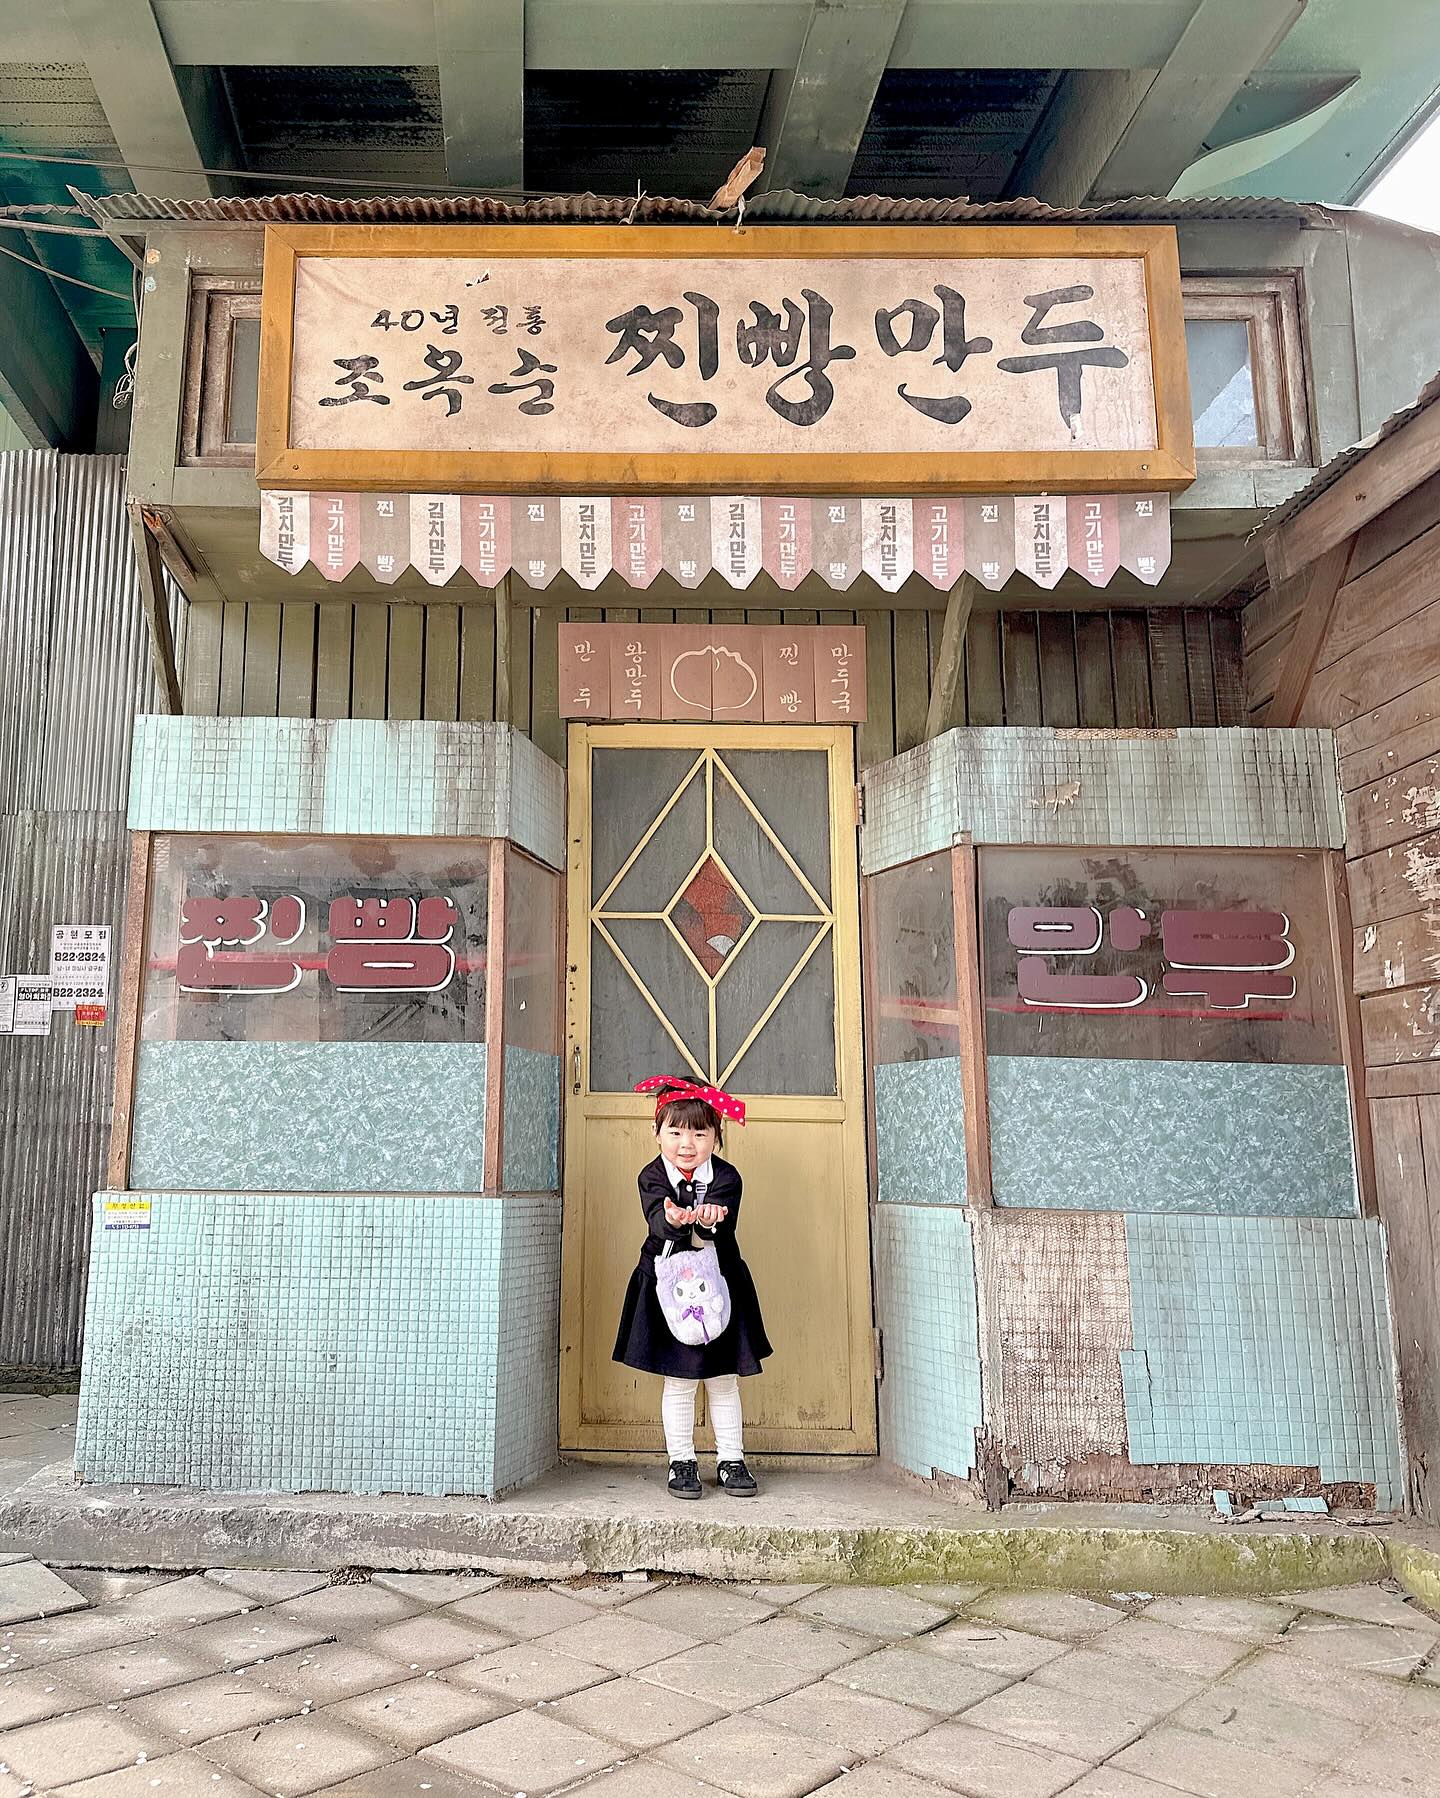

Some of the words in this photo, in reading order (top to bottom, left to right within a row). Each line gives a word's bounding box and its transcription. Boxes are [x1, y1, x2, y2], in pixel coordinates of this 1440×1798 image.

[371, 304, 459, 335] 40년
[480, 304, 547, 335] 전통
[318, 344, 558, 417] 조옥순
[277, 497, 296, 567] 김치만두
[327, 498, 345, 569] 고기만두
[428, 502, 446, 575] 김치만두
[478, 503, 497, 575] 고기만두
[579, 504, 597, 578] 김치만두
[629, 504, 647, 577] 고기만두
[729, 503, 747, 578] 김치만두
[779, 505, 796, 578] 고기만두
[879, 505, 898, 580] 김치만두
[930, 506, 949, 580] 고기만두
[1033, 503, 1052, 577] 김치만두
[1085, 502, 1103, 577] 고기만두
[624, 641, 648, 711] 왕만두
